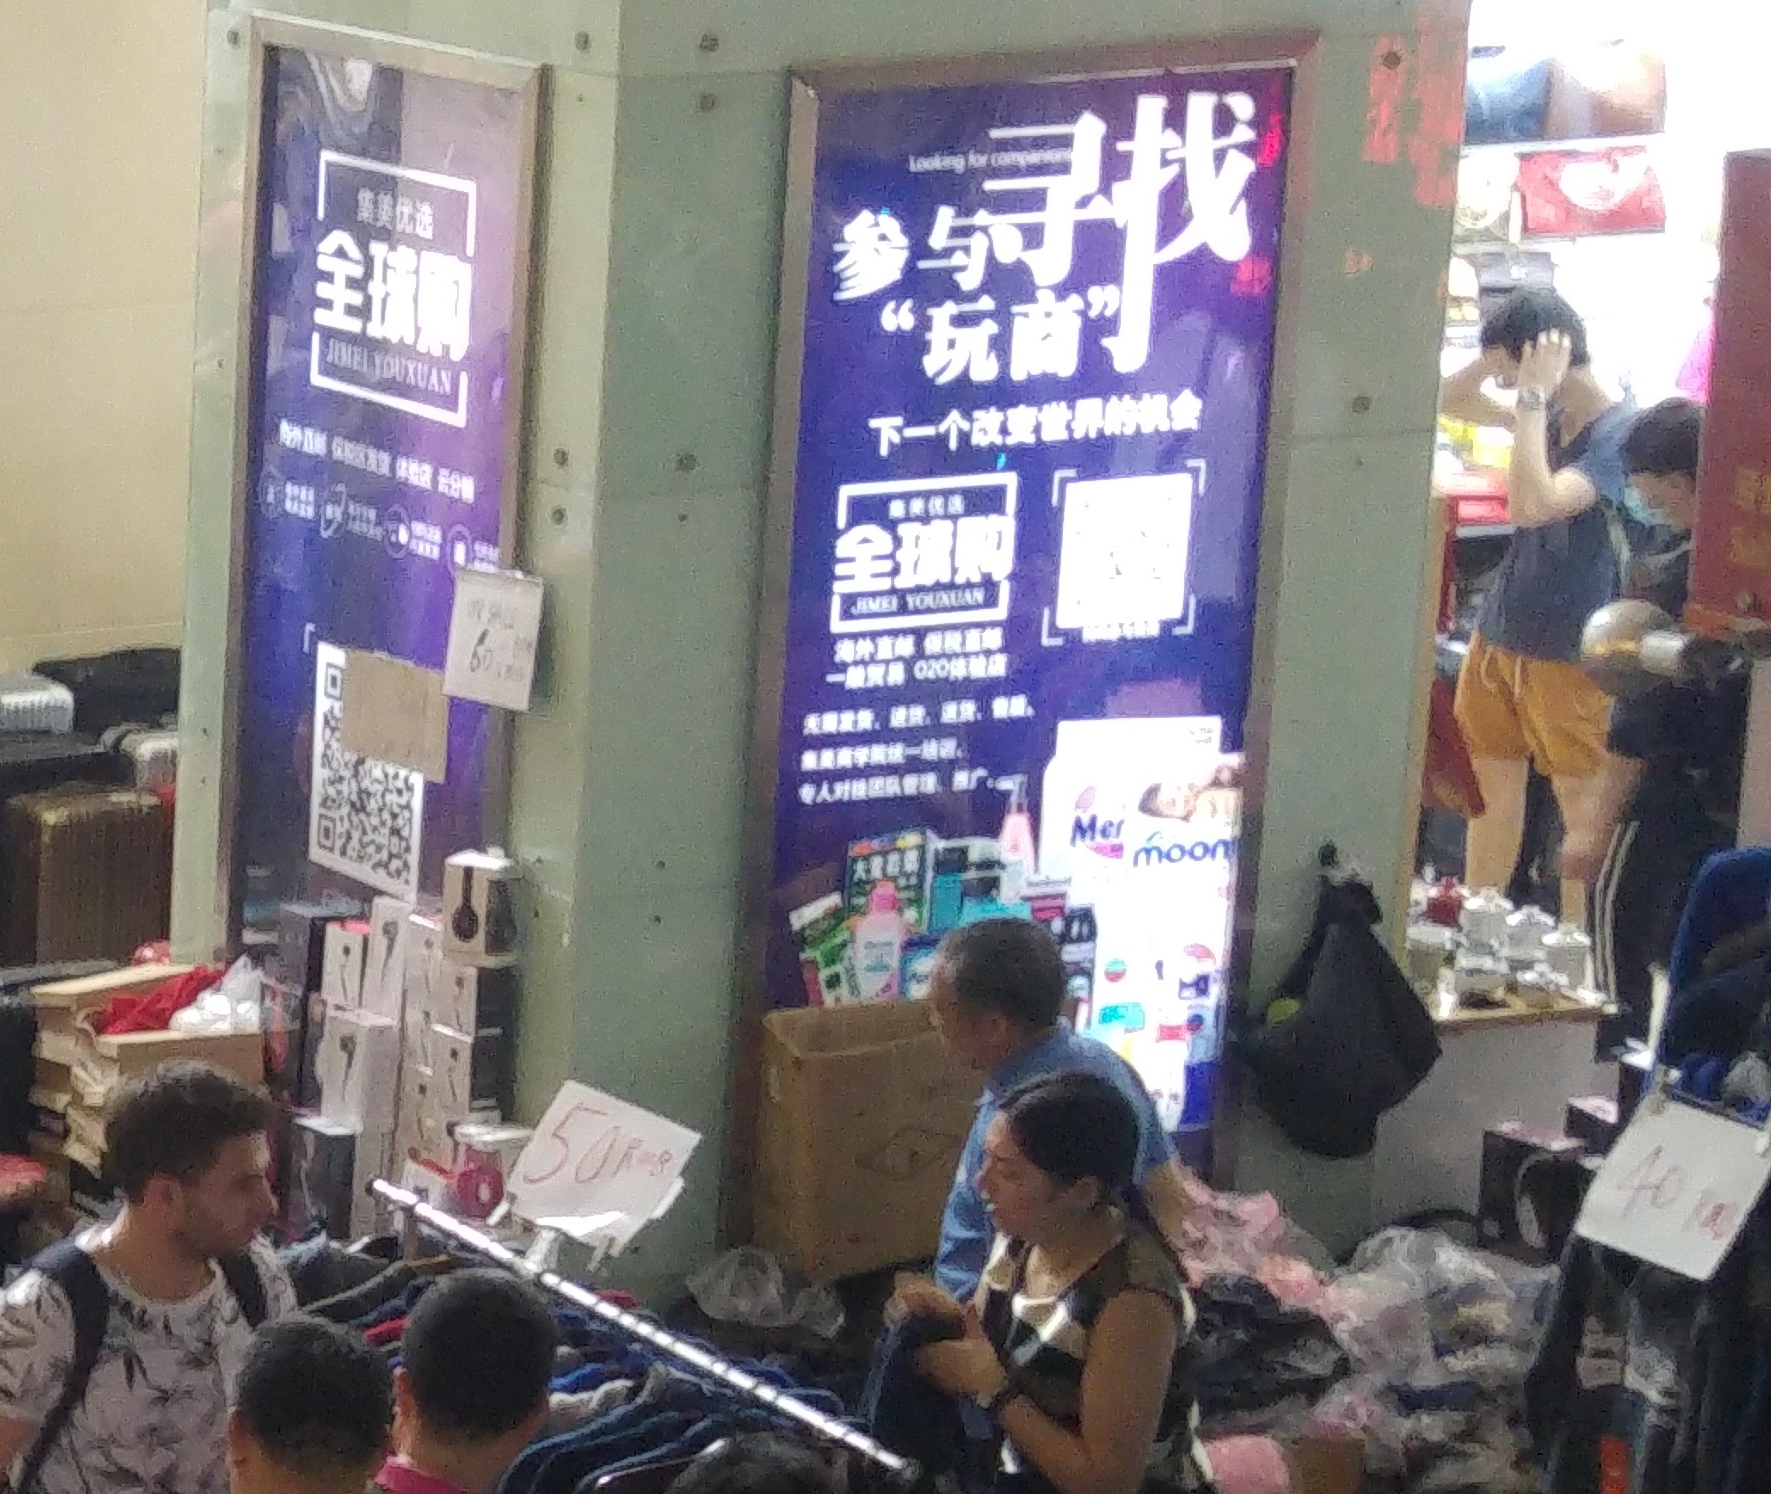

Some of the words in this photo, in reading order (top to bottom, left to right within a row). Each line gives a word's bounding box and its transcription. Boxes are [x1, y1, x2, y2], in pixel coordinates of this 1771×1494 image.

[833, 205, 989, 301] 参与
[982, 90, 1257, 374] 寻找
[868, 389, 1204, 458] 下一个改变世界的机会
